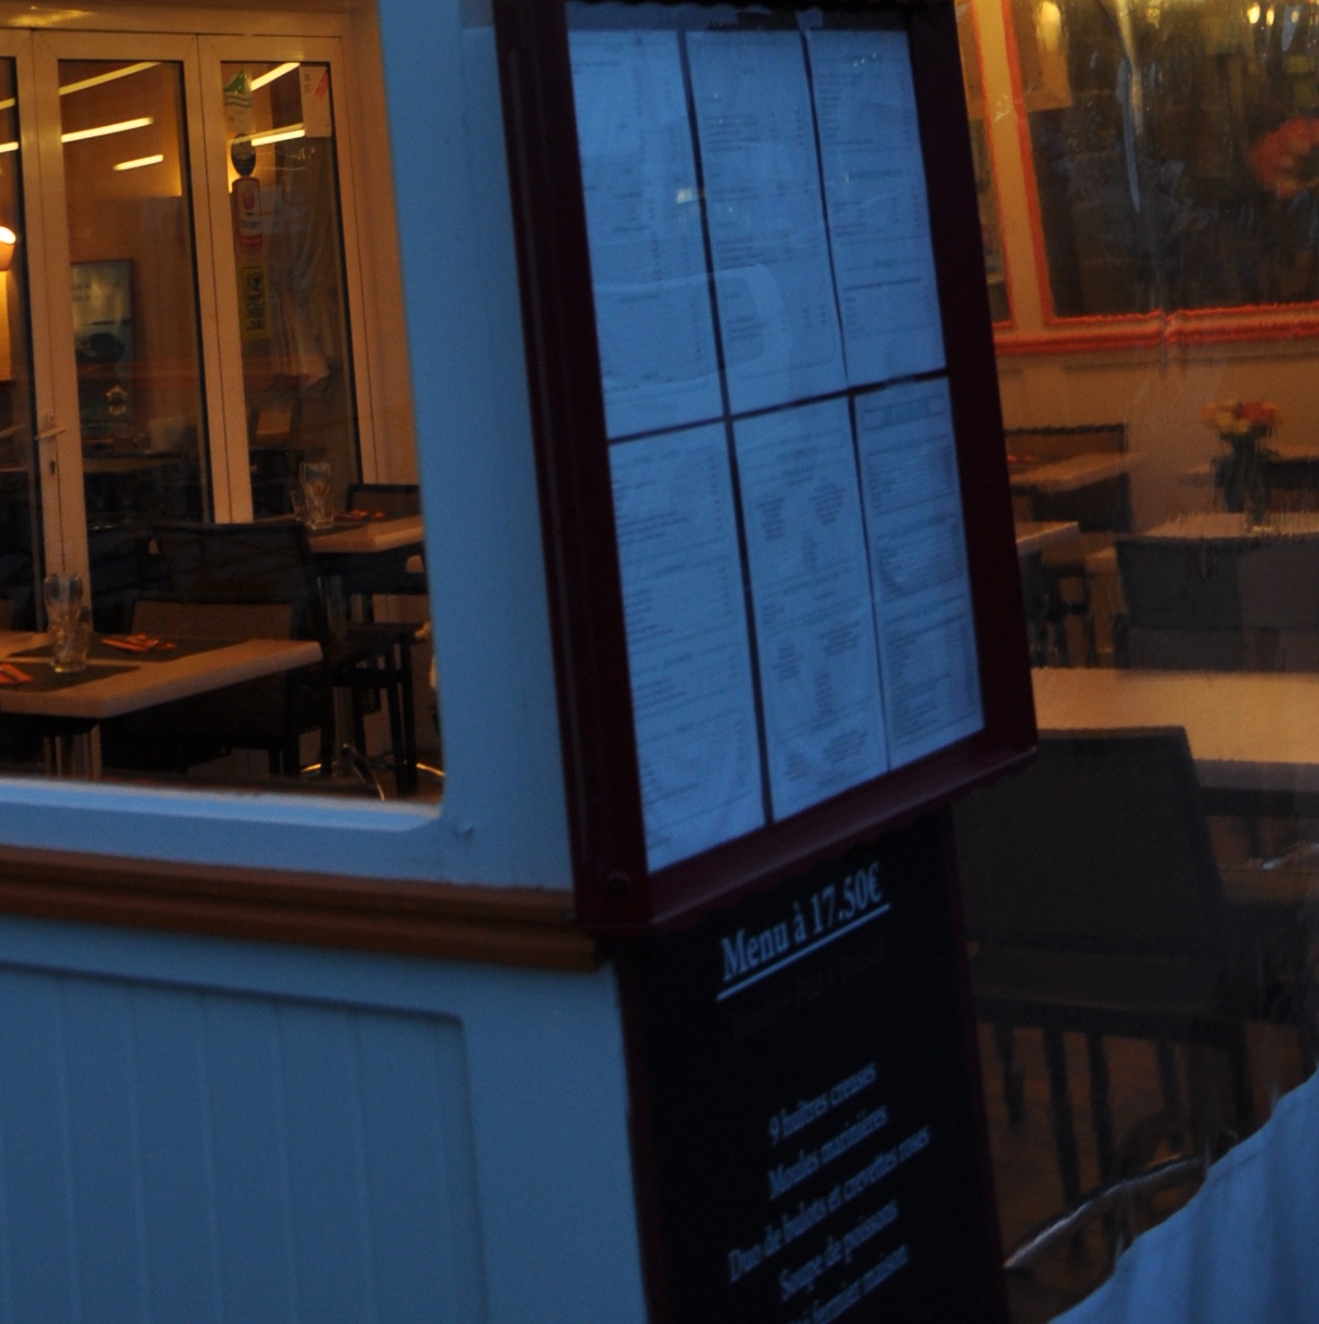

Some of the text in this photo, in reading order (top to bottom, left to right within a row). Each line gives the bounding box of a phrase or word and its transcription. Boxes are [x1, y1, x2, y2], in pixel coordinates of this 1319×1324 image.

[721, 862, 883, 982] Menu à 17.50€
[769, 1116, 779, 1147] 9
[768, 1148, 820, 1197] Moules
[728, 1243, 762, 1284] Duo
[764, 1223, 783, 1258] de
[779, 1253, 823, 1302] Soupe
[824, 1234, 842, 1267] de
